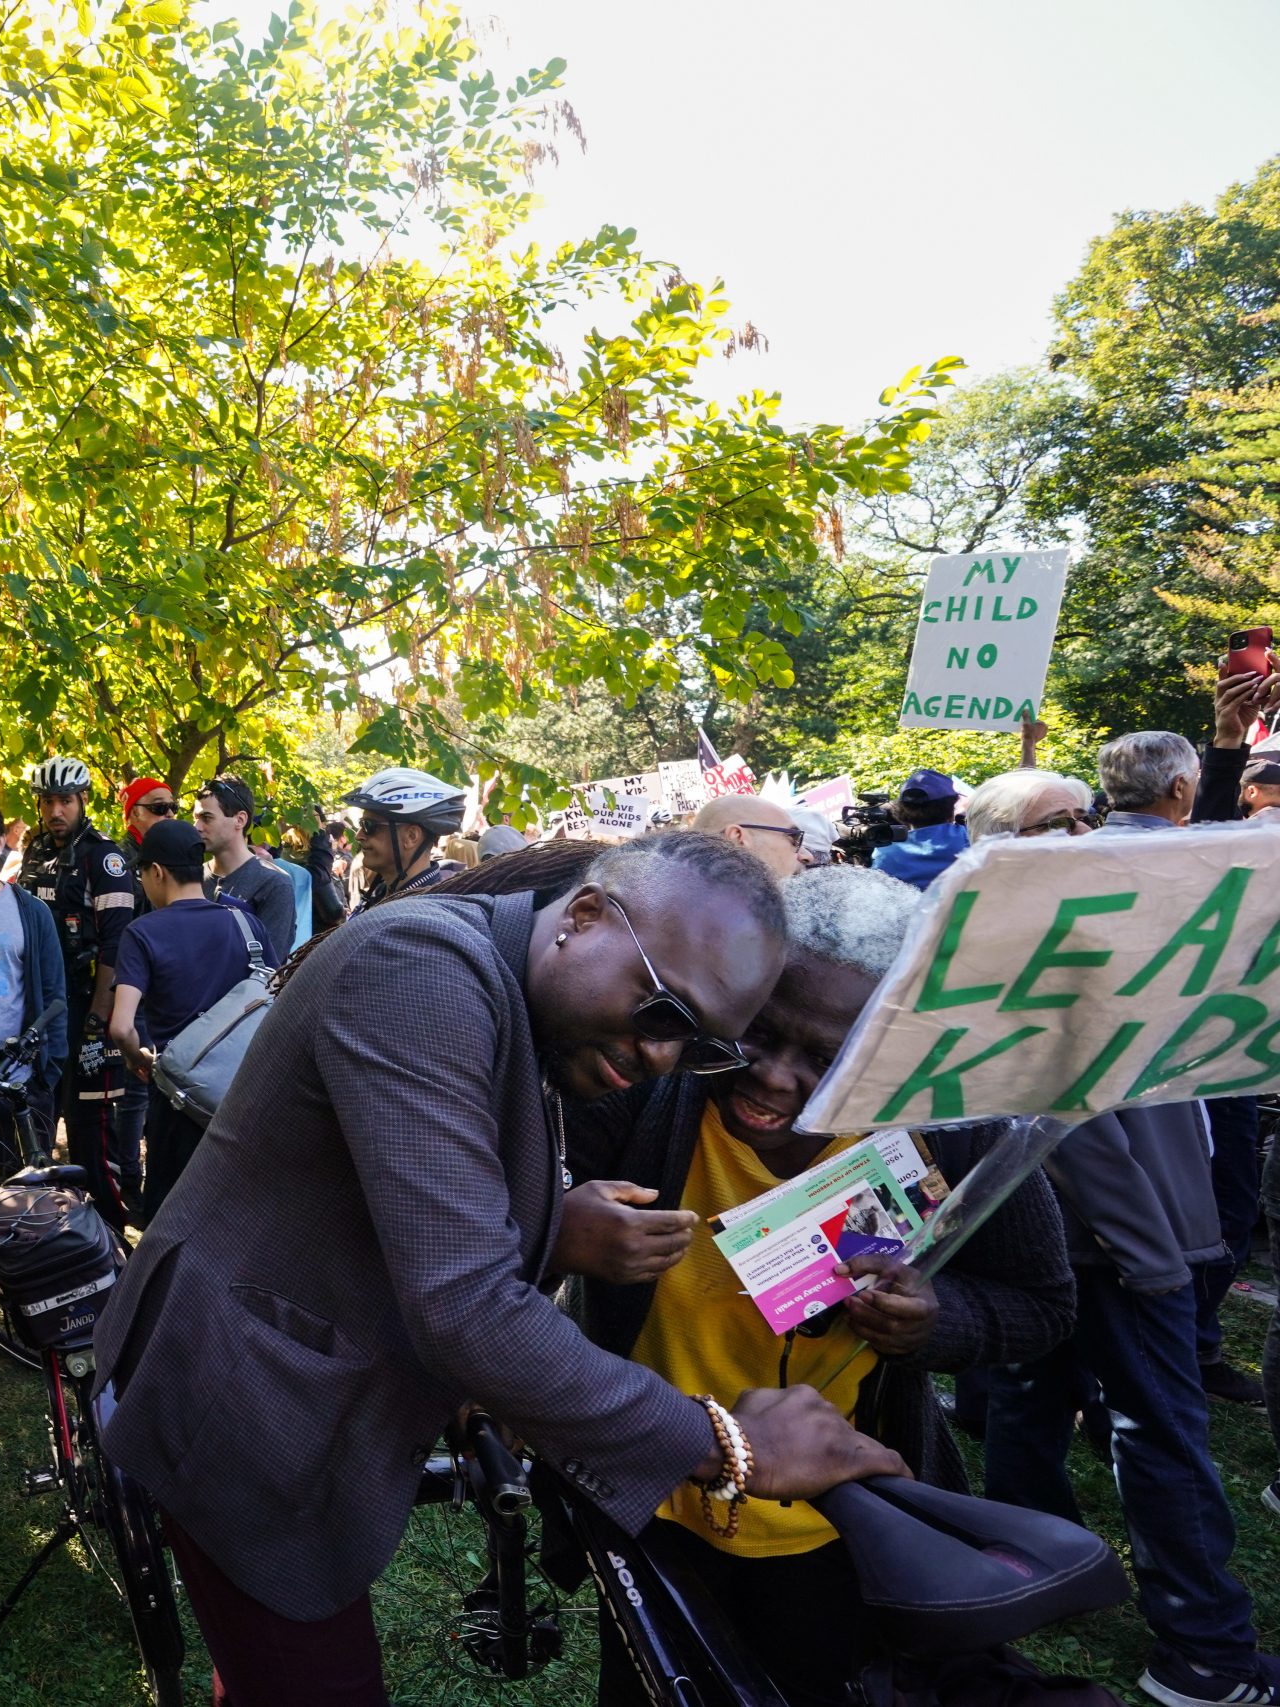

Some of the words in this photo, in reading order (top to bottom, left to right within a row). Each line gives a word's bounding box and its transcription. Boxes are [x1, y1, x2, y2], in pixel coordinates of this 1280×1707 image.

[962, 556, 1021, 587] MY
[922, 595, 1038, 623] CHILD
[946, 643, 998, 669] NO
[902, 691, 1037, 724] AGENDA
[623, 776, 643, 787] MY
[602, 803, 635, 813] LAVE
[617, 812, 642, 822] KIDS
[598, 818, 633, 829] ALONE
[852, 1158, 871, 1171] STAND
[844, 1168, 853, 1176] UP
[896, 1169, 919, 1186] Com
[832, 1174, 844, 1183] FOR
[807, 1181, 834, 1199] FREEDOM
[783, 1248, 794, 1256] that
[766, 1254, 783, 1266] Canada
[801, 1282, 823, 1299] okay
[794, 1294, 804, 1303] to
[60, 1313, 95, 1332] JANDD
